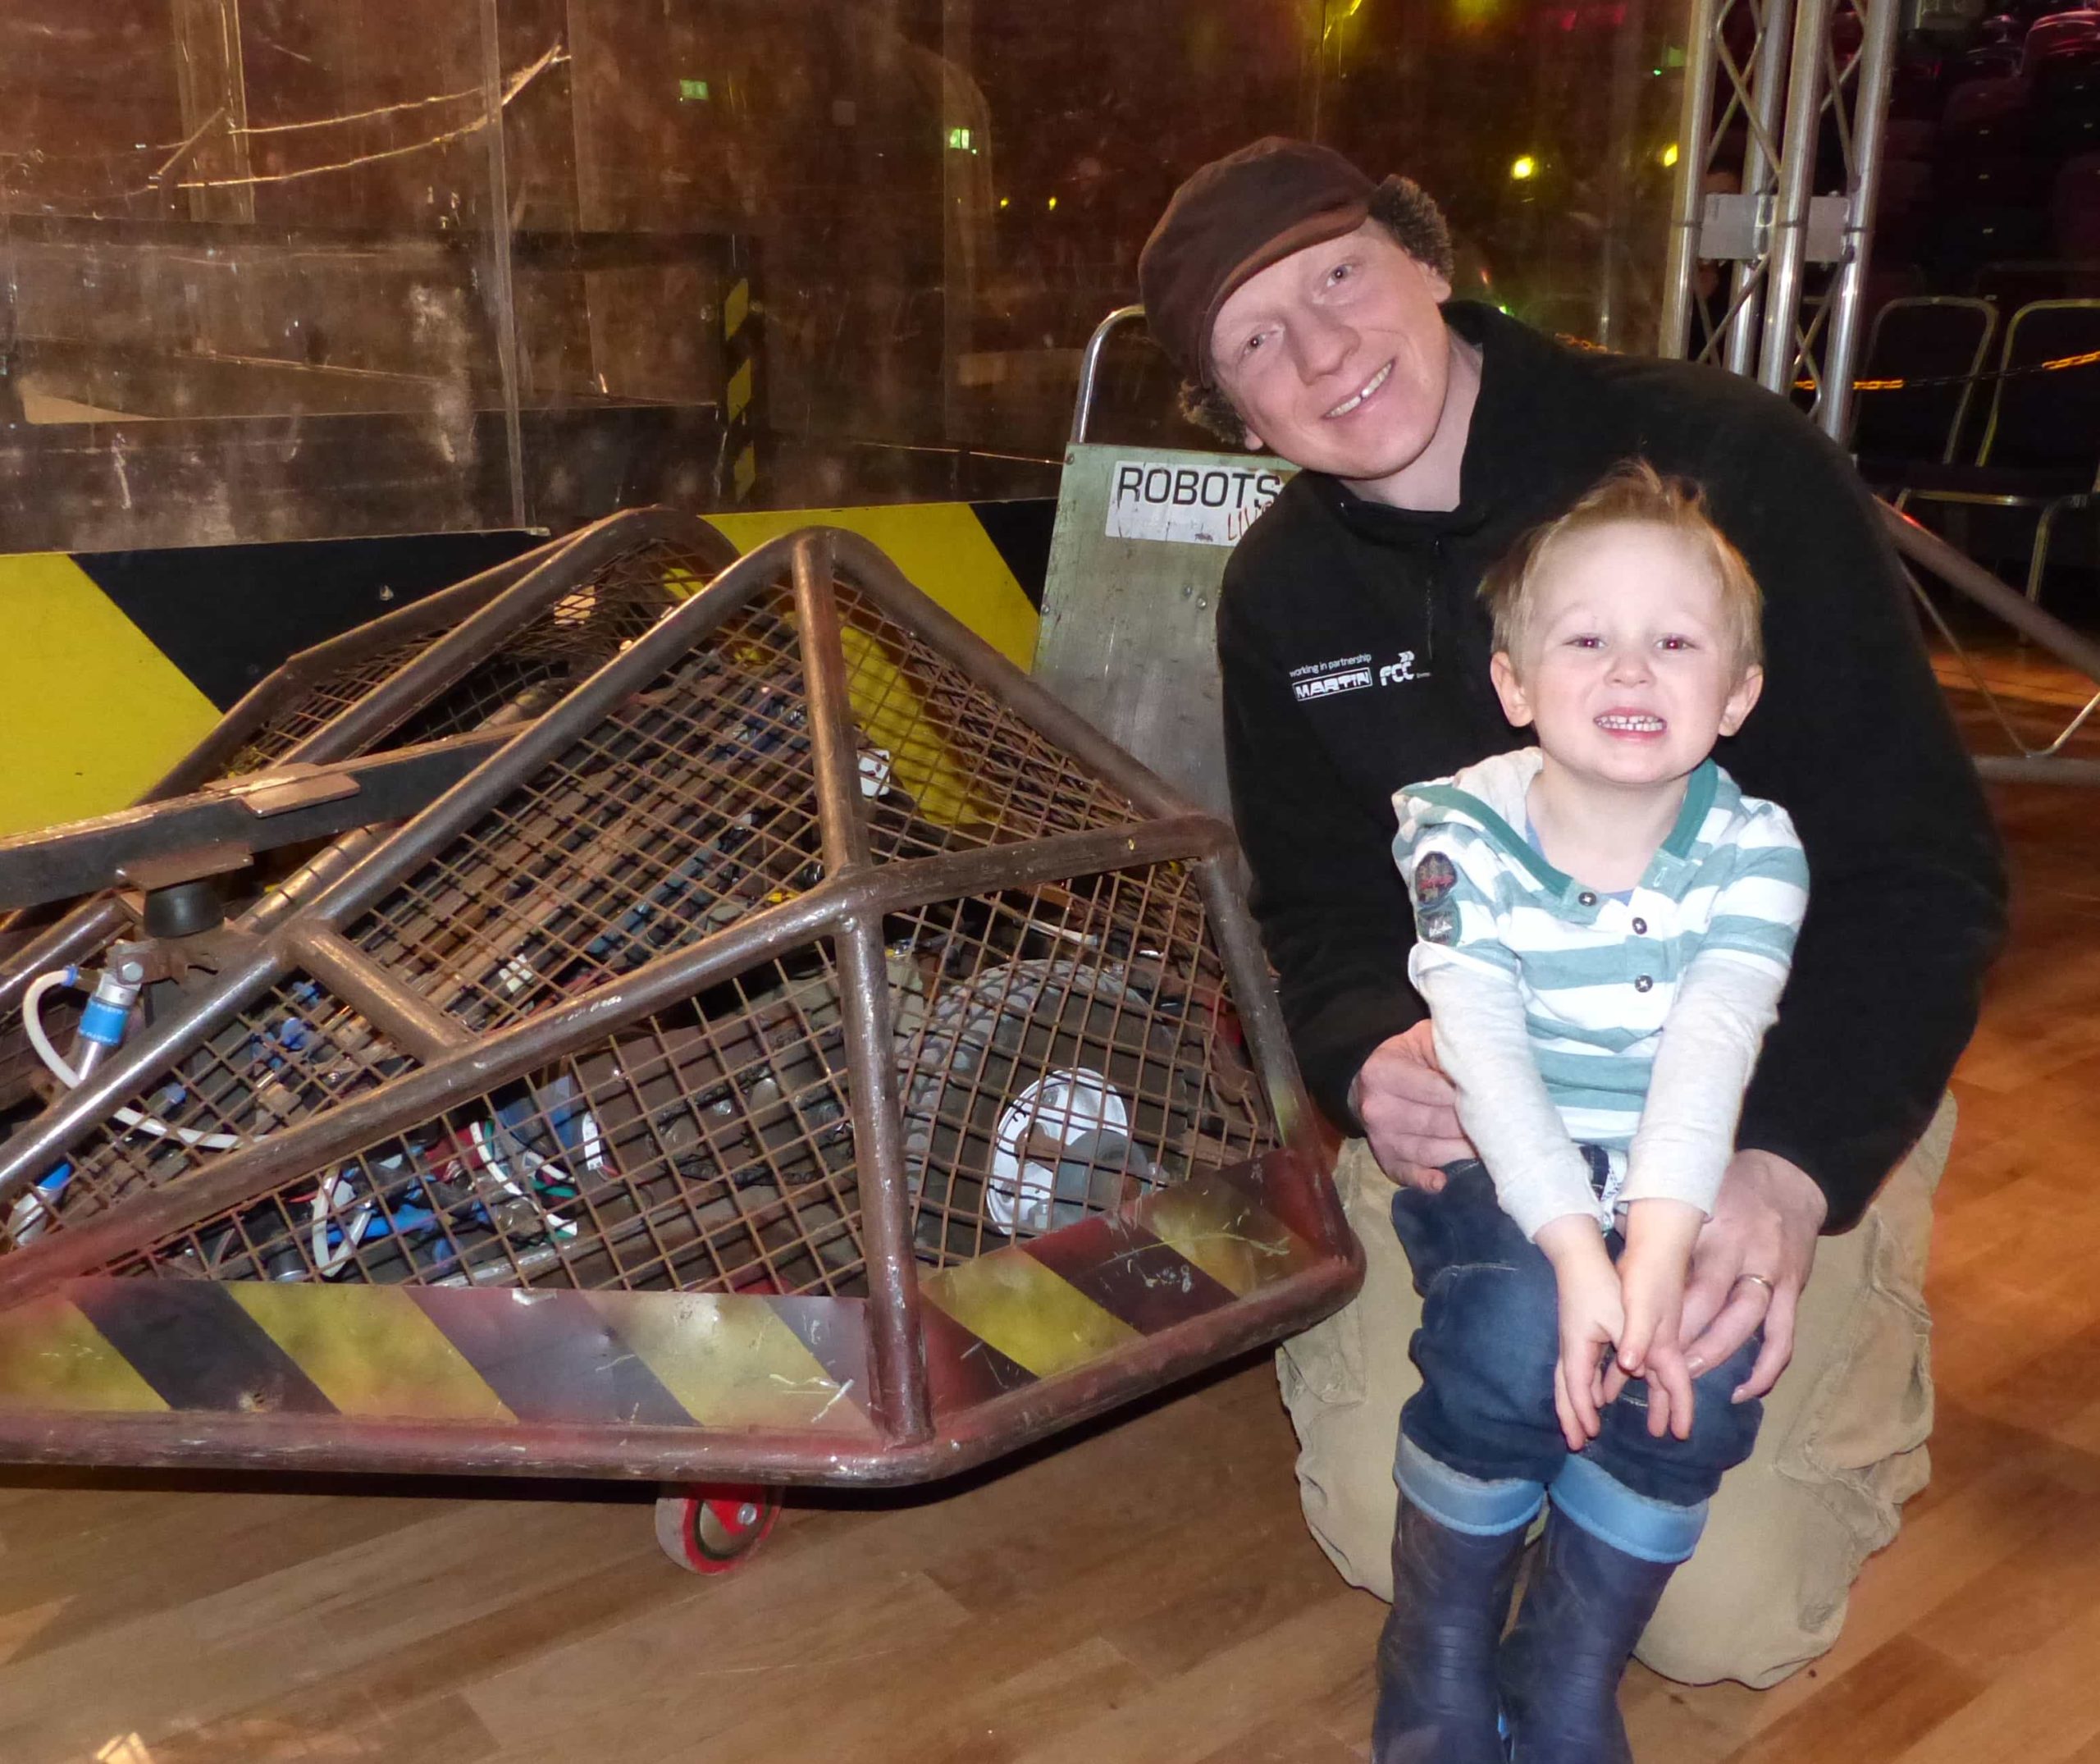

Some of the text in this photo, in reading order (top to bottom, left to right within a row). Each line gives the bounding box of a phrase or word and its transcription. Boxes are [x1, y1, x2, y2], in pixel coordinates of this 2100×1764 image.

[1118, 467, 1281, 510] ROBOTS
[1289, 653, 1372, 678] working in partnership
[1295, 671, 1370, 698] MARTIN
